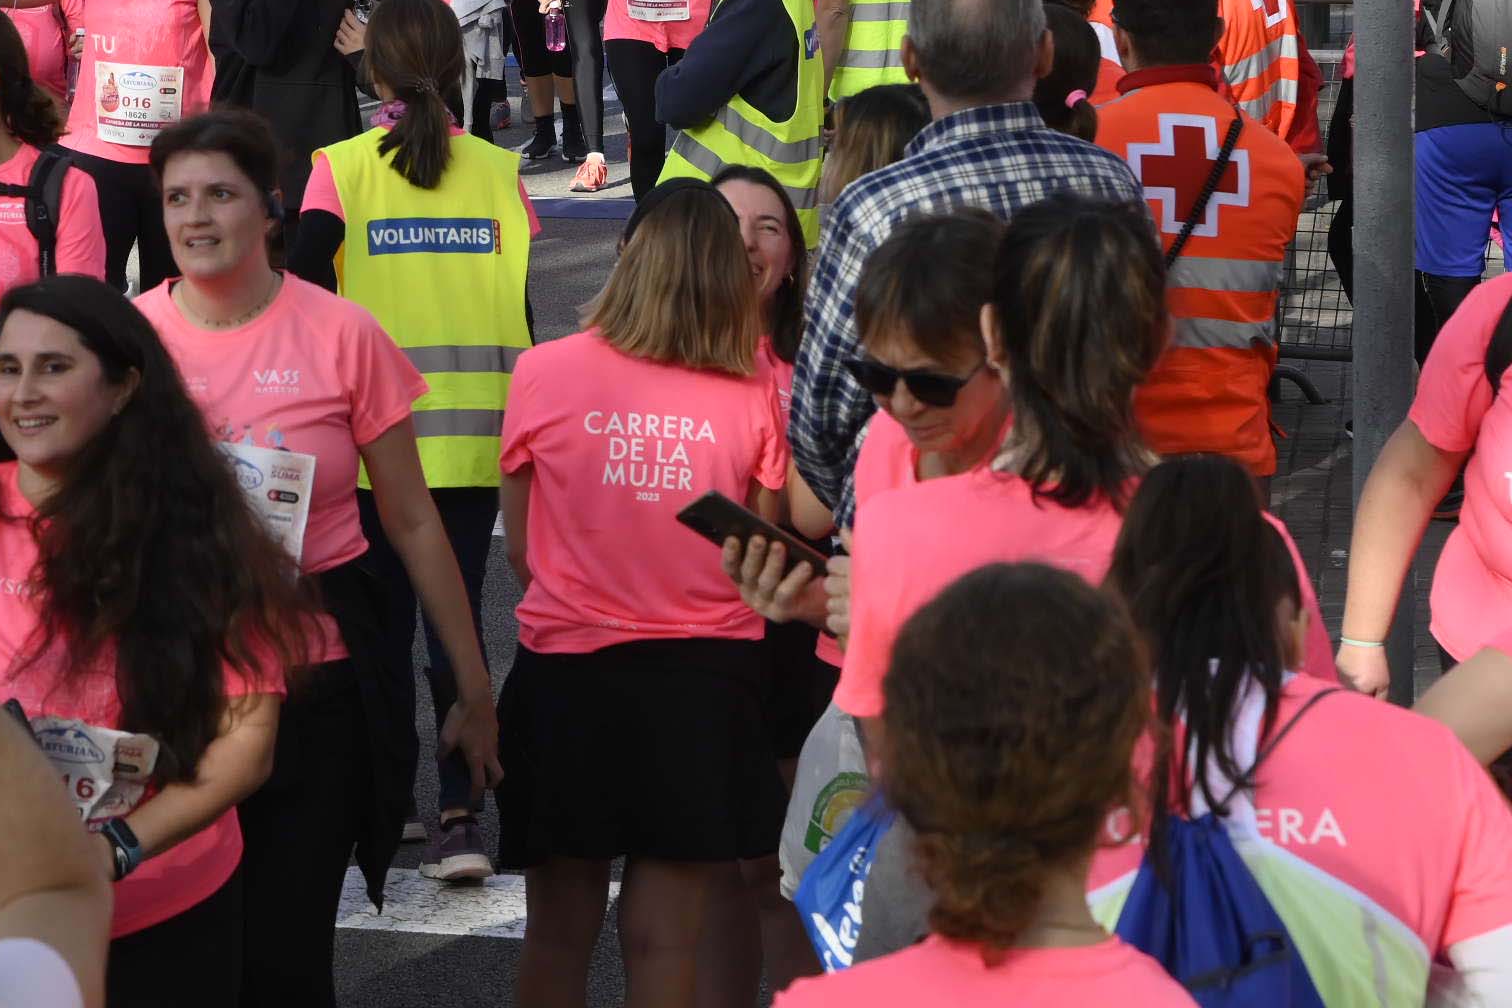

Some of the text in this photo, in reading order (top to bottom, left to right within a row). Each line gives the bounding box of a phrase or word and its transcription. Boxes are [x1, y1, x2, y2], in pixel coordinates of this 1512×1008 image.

[91, 34, 116, 54] TU
[122, 96, 151, 109] 016
[125, 111, 147, 119] 18626
[371, 226, 491, 247] VOLUNTARIS
[253, 369, 300, 385] VASS
[584, 411, 716, 443] CARRERA
[609, 438, 689, 465] DE LA
[602, 462, 693, 491] MUJER
[636, 492, 660, 503] 2023
